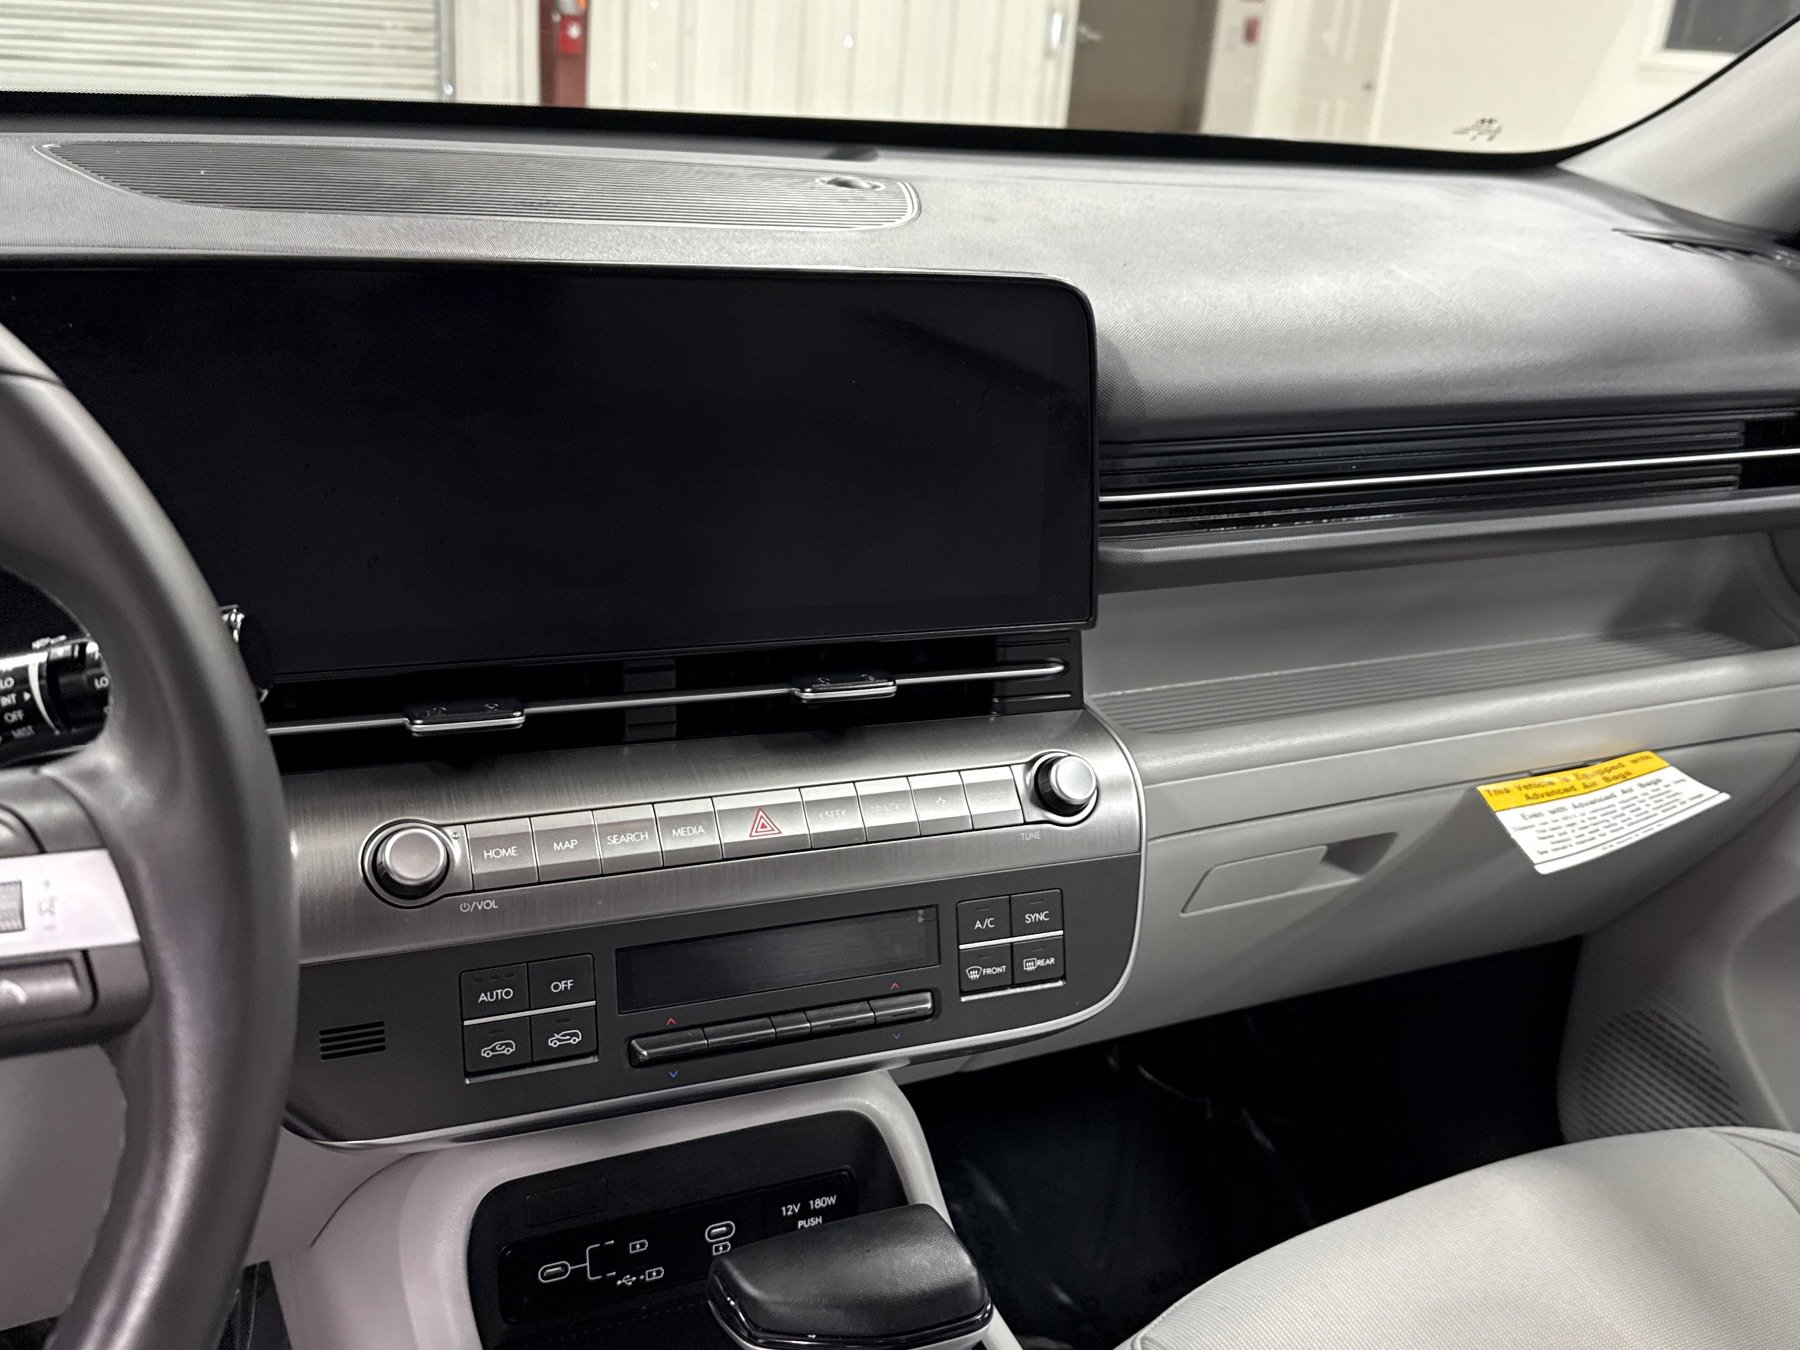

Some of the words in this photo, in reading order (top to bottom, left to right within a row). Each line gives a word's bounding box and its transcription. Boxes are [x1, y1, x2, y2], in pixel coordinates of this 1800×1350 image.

[95, 677, 109, 690] LO
[4, 709, 24, 724] OFF
[1524, 785, 1577, 801] Advanced
[1582, 781, 1598, 790] Air
[1602, 771, 1632, 783] Bags
[607, 831, 649, 846] SEARCH
[671, 825, 706, 838] MEDIA
[1020, 830, 1041, 841] TUNE
[553, 839, 578, 851] MAP
[483, 846, 518, 860] HOME
[974, 917, 996, 930] A/C
[1025, 910, 1050, 924] SYNC
[1036, 957, 1056, 967] REAR
[982, 965, 1007, 976] FRONT
[550, 979, 574, 993] OFF
[478, 987, 514, 1003] AUTO
[781, 1202, 801, 1217] 12V
[809, 1194, 837, 1210] 180W
[797, 1215, 823, 1229] PUSH
